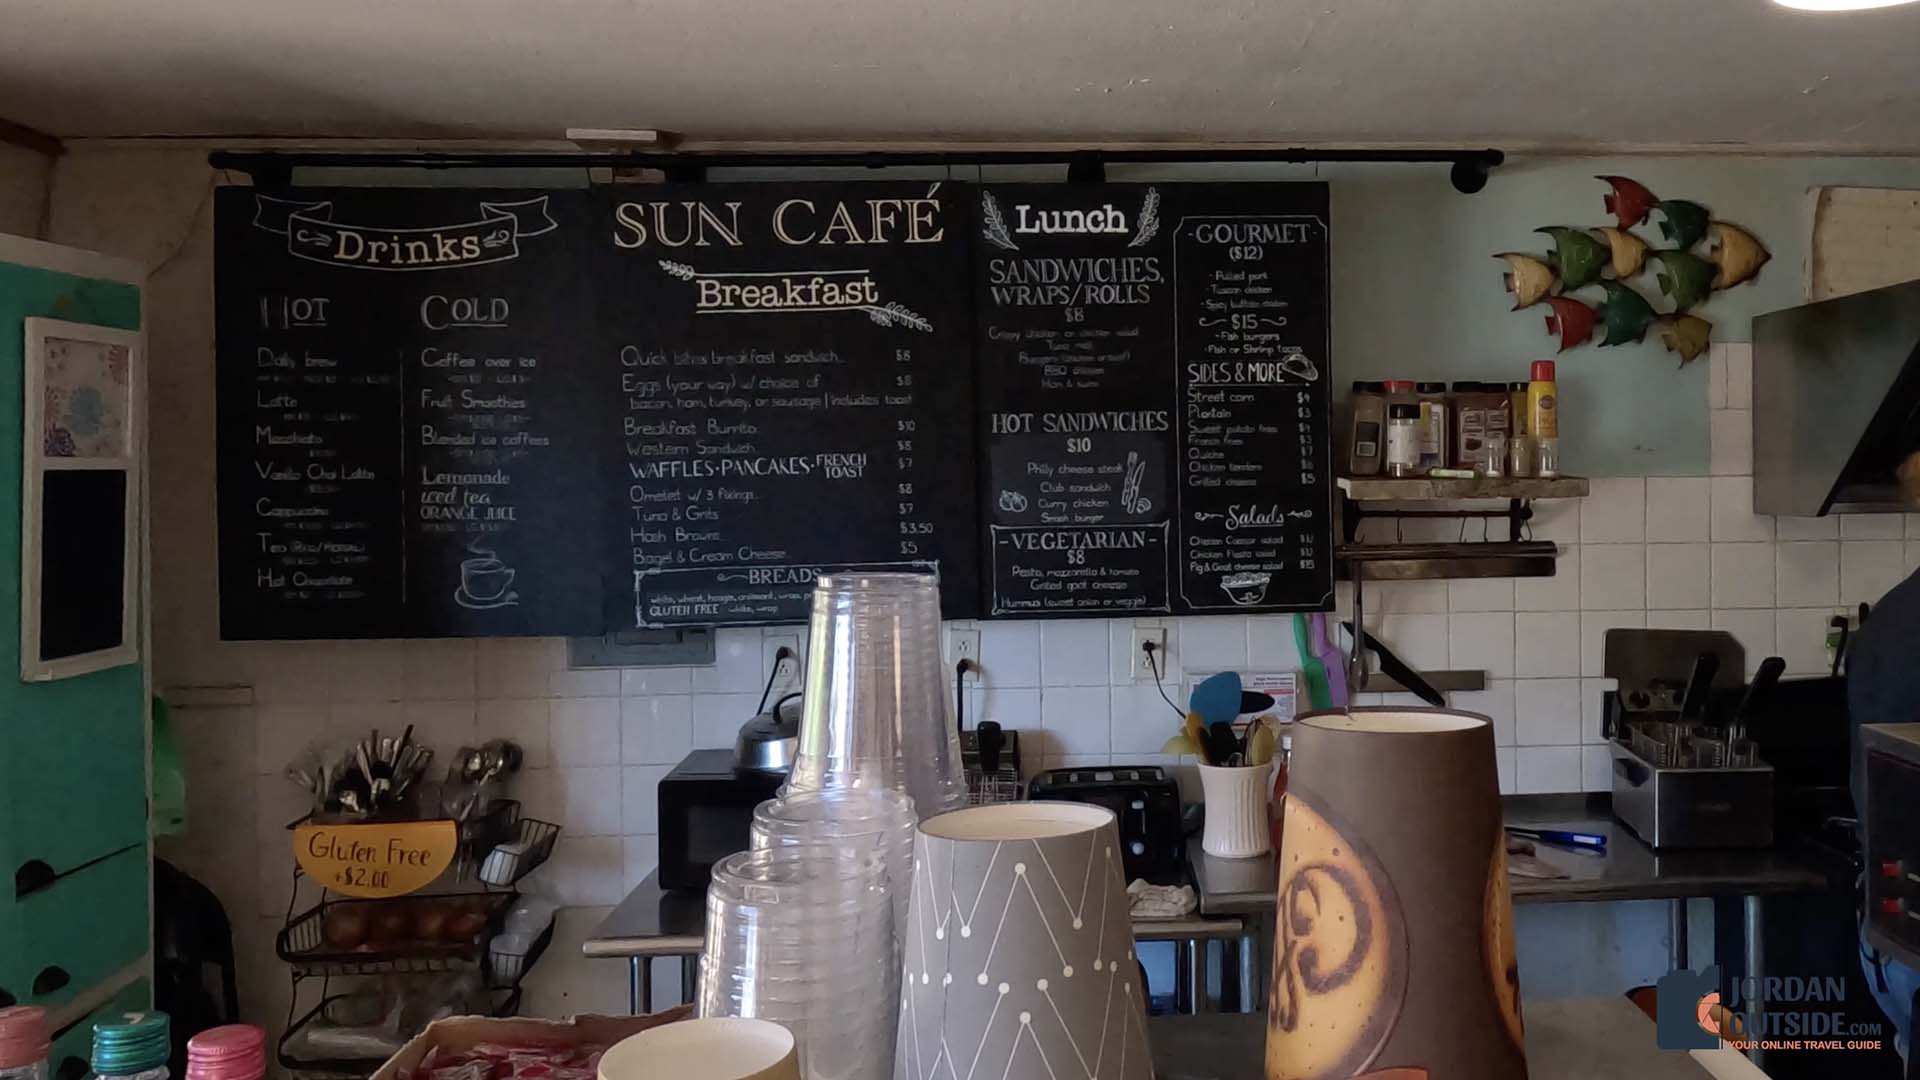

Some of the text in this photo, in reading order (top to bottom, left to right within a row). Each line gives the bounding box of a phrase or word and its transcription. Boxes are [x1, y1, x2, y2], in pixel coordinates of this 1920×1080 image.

[614, 182, 945, 248] SUN CAFÉ
[1014, 204, 1129, 234] Lunch
[1195, 223, 1311, 244] GOURMET
[334, 231, 480, 264] Drinks
[1228, 245, 1264, 262] ($12)
[989, 257, 1165, 285] SANDWICHES,
[696, 277, 879, 308] Breakfast
[990, 284, 1151, 306] WRAPS/ROLLS
[421, 296, 509, 330] COLD
[1231, 313, 1258, 330] $15
[1187, 362, 1285, 383] SIDES & MORE
[622, 373, 661, 398] Eggs
[666, 373, 704, 396] (your
[707, 373, 736, 394] way)
[1187, 387, 1225, 403] Street
[624, 417, 696, 436] Breakfast
[992, 411, 1168, 434] HOT SANDWICHES
[626, 443, 688, 456] Western
[1067, 437, 1092, 453] $10
[421, 465, 510, 485] Lemonade
[629, 453, 913, 479] WAFFLES PANCAKES FRENCH $7
[824, 466, 864, 479] TOAST
[1027, 461, 1053, 477] Philly
[1058, 463, 1094, 474] cheese
[706, 489, 714, 500] 3
[898, 483, 912, 494] $8
[1040, 481, 1065, 493] Club
[421, 486, 491, 508] iced tea
[1038, 499, 1109, 512] Curry chicken
[420, 505, 517, 520] ORANGE JUICE
[632, 503, 914, 521] Tuna & Grits $7
[1225, 504, 1285, 531] Salads
[630, 527, 667, 543] Hash
[1011, 530, 1146, 550] VEGETARIAN
[632, 547, 672, 567] Bagel
[677, 550, 686, 563] &
[689, 547, 734, 563] Cream
[900, 541, 918, 554] $5
[1067, 550, 1085, 565] $8
[749, 568, 823, 585] BREADS
[649, 605, 690, 617] GLUTEN
[694, 603, 720, 616] FREE
[1000, 595, 1041, 608] Hummus
[309, 831, 431, 865] Gluten Free
